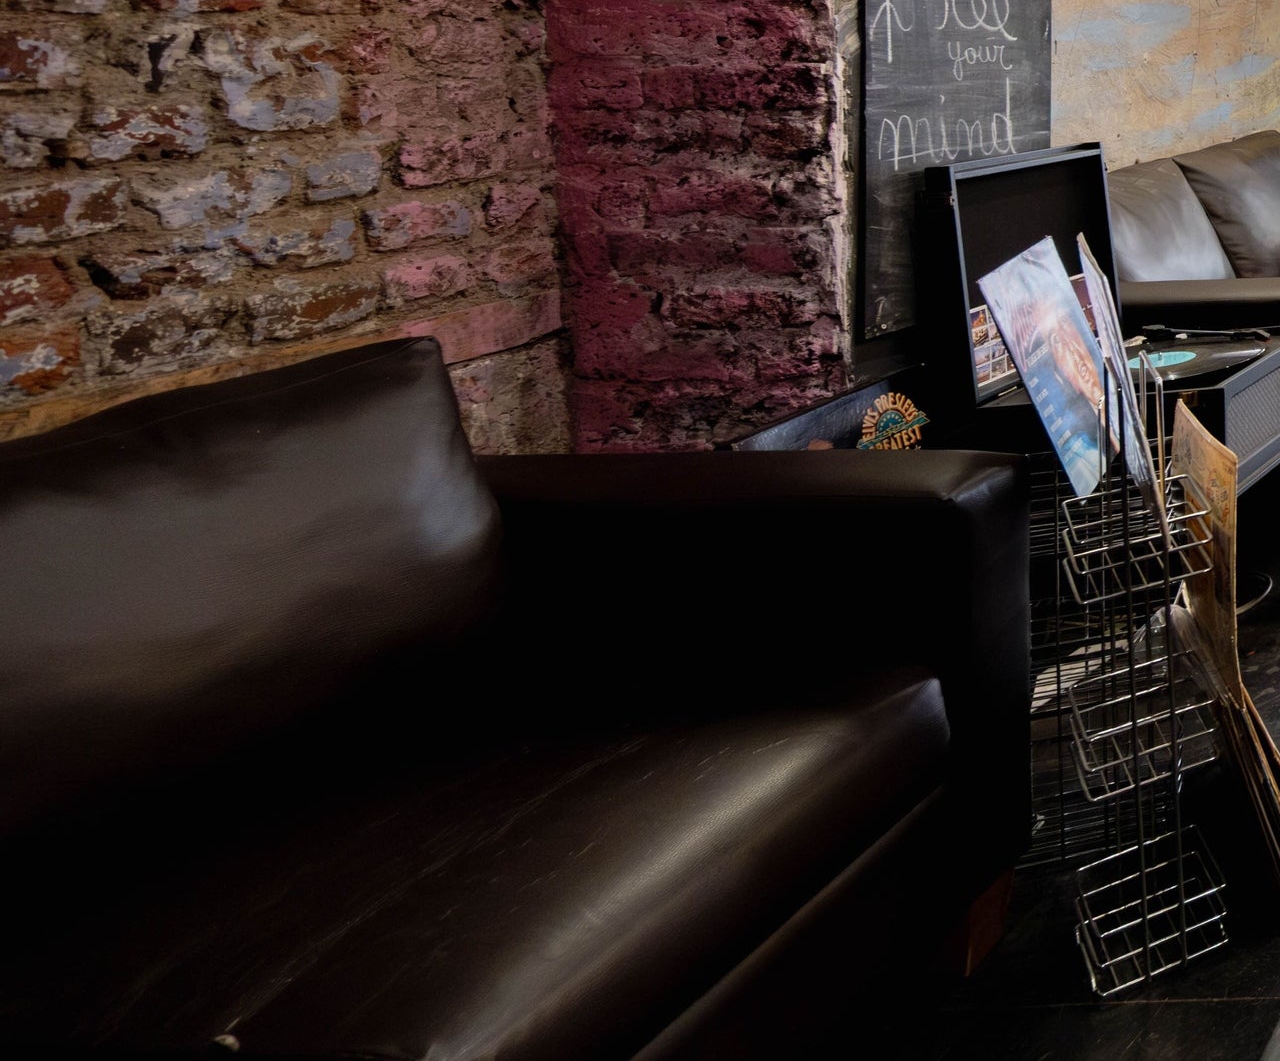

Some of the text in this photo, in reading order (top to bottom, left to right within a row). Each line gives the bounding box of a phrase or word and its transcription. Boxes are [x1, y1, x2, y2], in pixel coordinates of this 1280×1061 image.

[948, 40, 1013, 81] your
[878, 76, 1017, 172] mind
[862, 407, 880, 442] ELVIS
